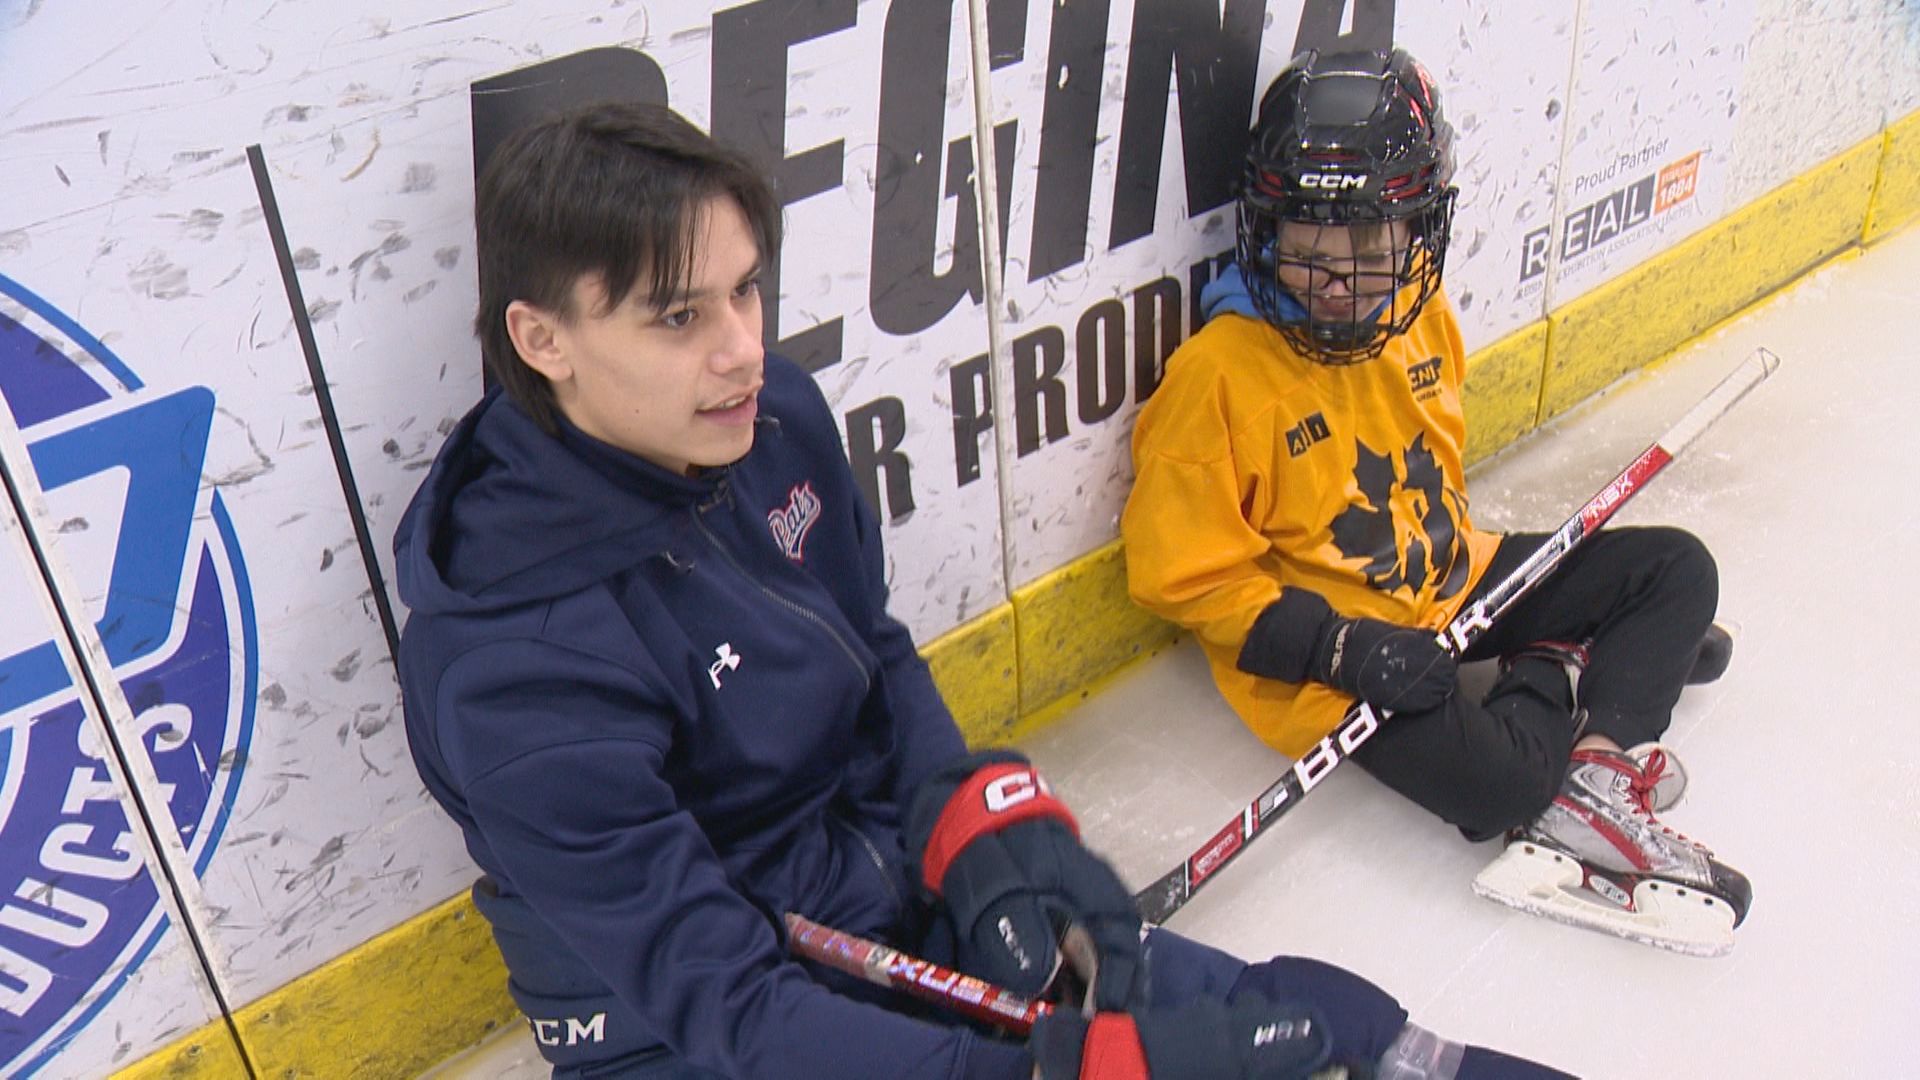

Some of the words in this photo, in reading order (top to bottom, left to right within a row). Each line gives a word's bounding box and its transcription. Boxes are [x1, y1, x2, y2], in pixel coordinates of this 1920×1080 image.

[1299, 173, 1368, 189] CCM
[1575, 161, 1617, 196] Proud
[1620, 138, 1669, 174] Partner
[471, 0, 1396, 398] EGIN
[1520, 177, 1654, 281] REAL
[527, 1011, 607, 1047] CM
